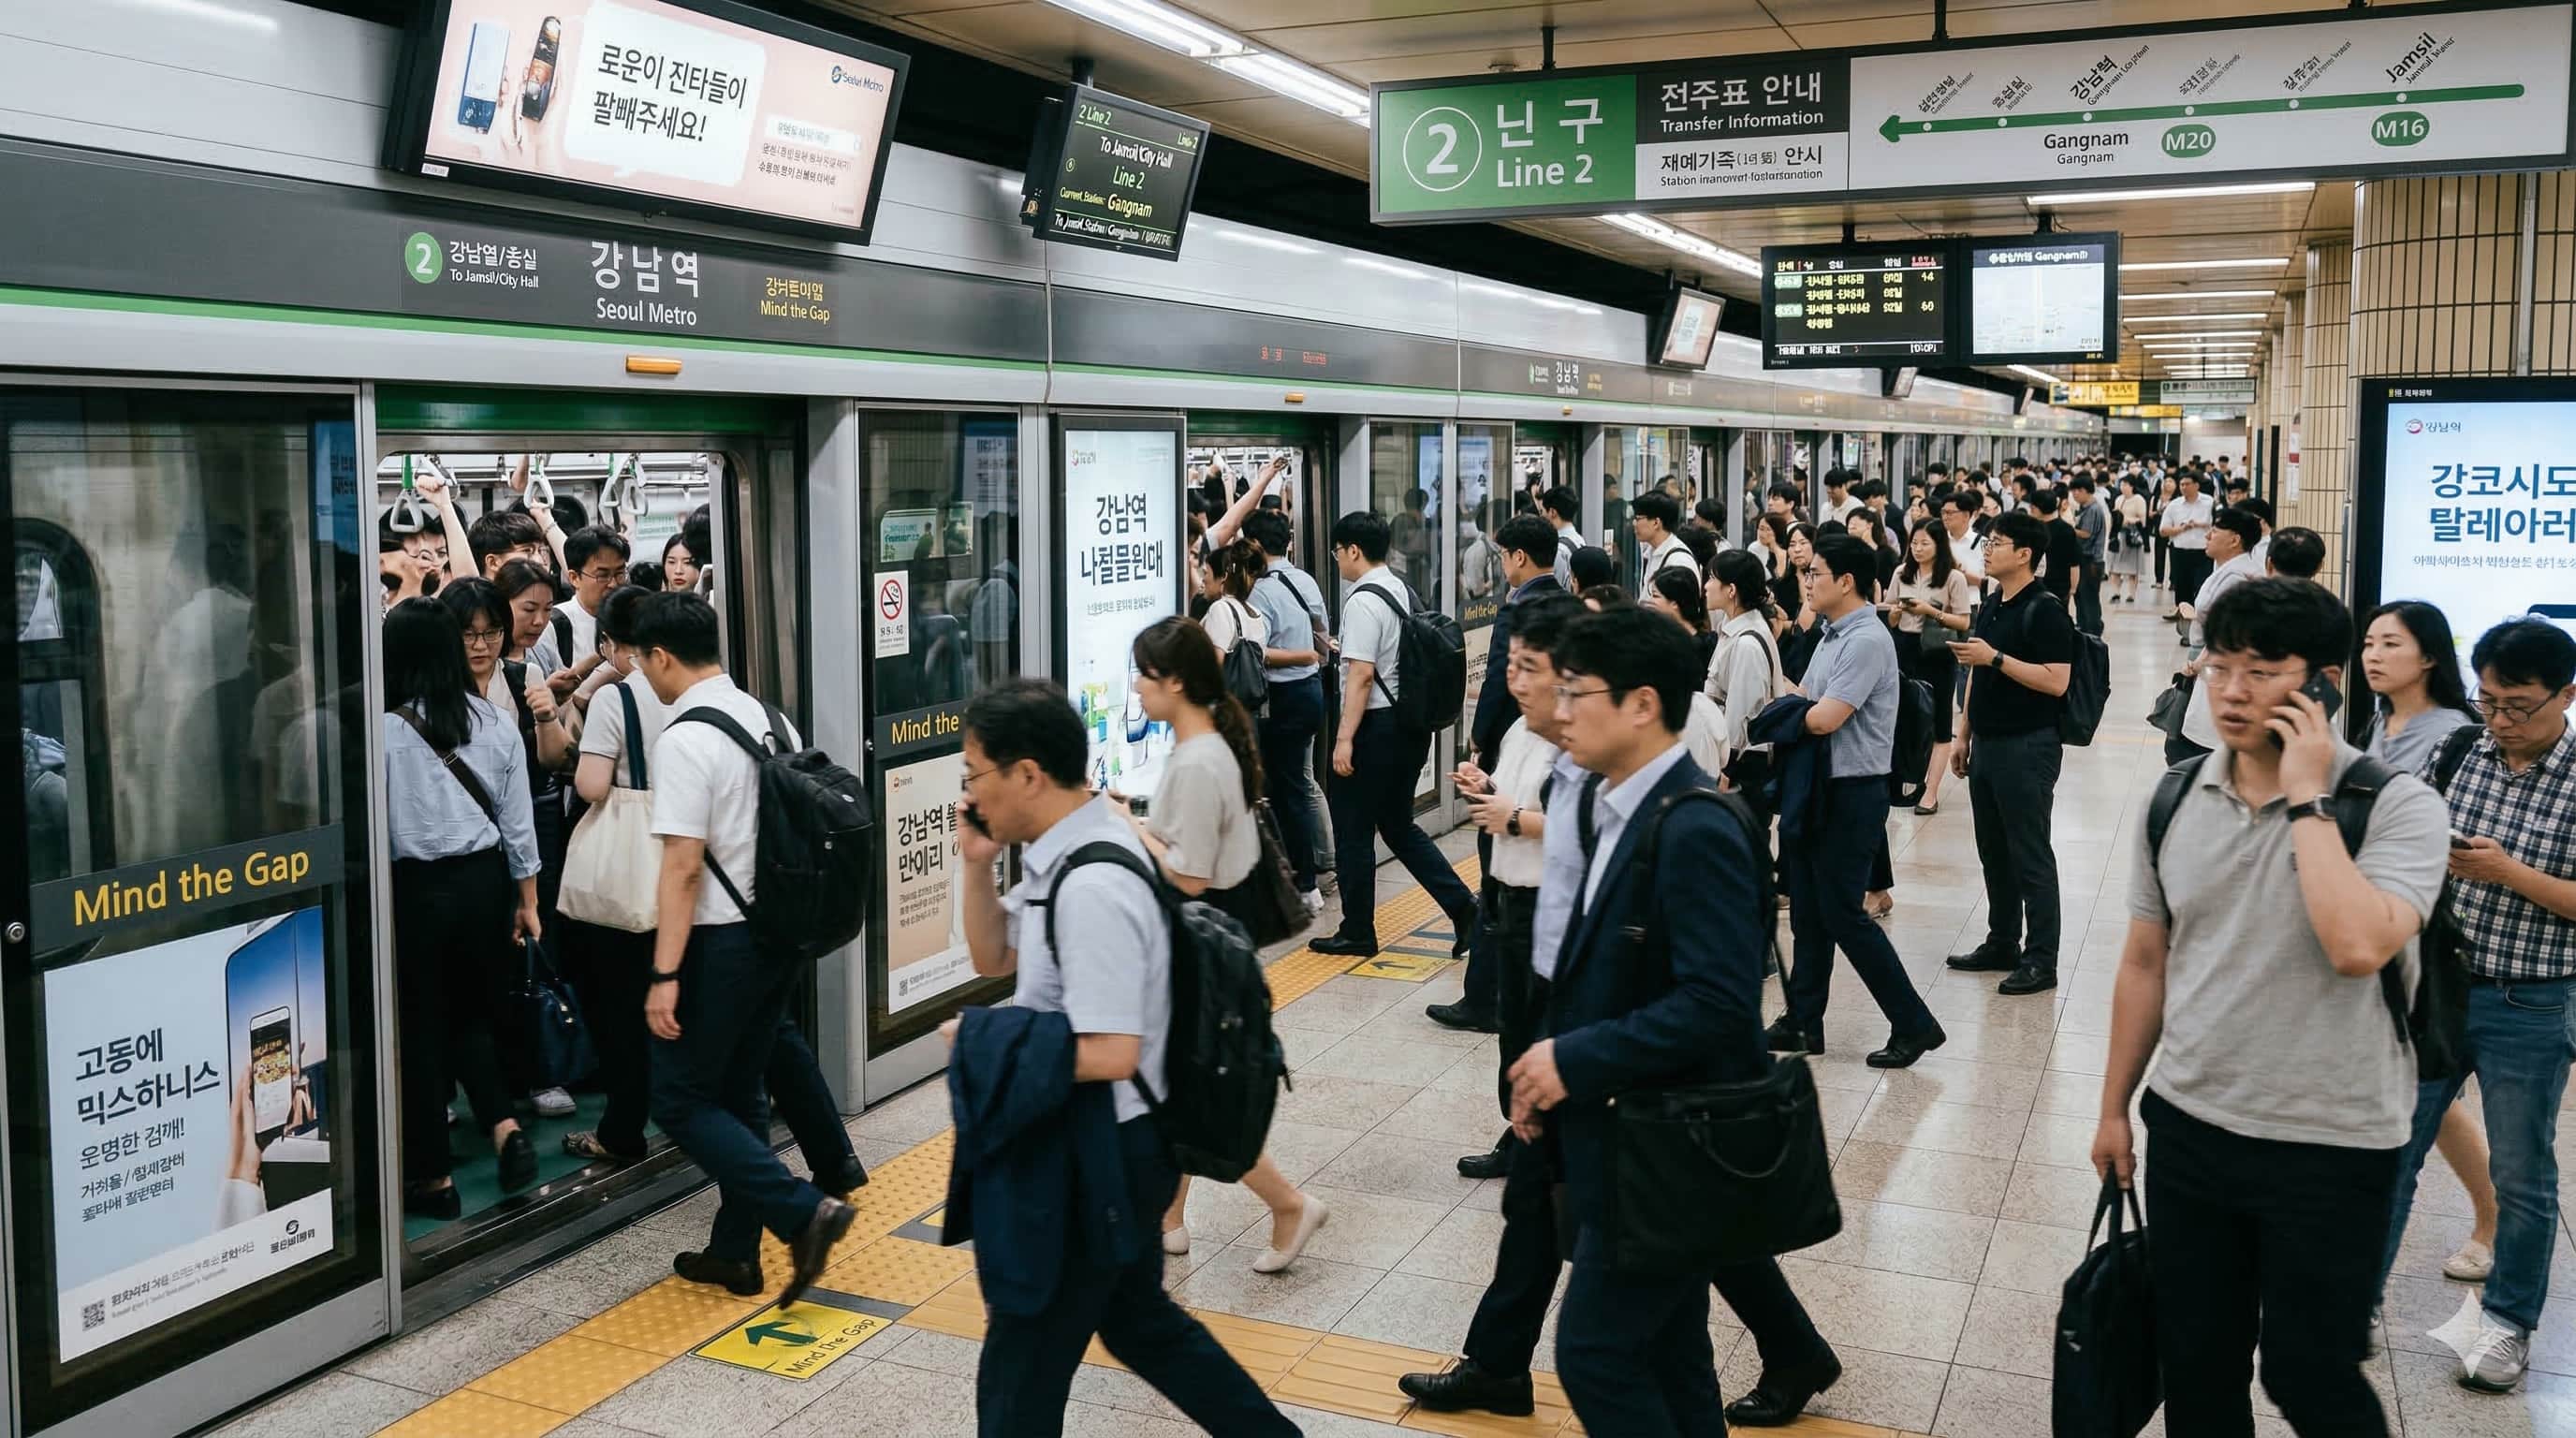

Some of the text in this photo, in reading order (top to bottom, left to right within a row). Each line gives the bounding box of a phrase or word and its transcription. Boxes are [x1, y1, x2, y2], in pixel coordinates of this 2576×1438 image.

[2385, 32, 2437, 83] Jamsil
[598, 44, 747, 110] 로운이 진타들이
[1661, 71, 1822, 112] 전주표 안내
[593, 90, 706, 141] 팔빼주세요!
[1087, 105, 1105, 123] Line
[1497, 97, 1603, 148] 닌 구
[1660, 110, 1823, 133] Transfer Information
[2376, 118, 2425, 139] M16
[1425, 123, 1458, 174] 2
[1784, 145, 1822, 166] 안시
[2043, 132, 2130, 152] Gangnam
[2165, 131, 2212, 151] M20
[1498, 154, 1594, 187] Line 2
[2056, 152, 2115, 166] Gangnam
[1113, 165, 1146, 190] Line 2
[1107, 193, 1153, 218] Gangnam
[415, 242, 433, 274] 2
[591, 240, 698, 299] 강남역
[449, 268, 463, 282] To
[520, 274, 538, 288] Hall
[596, 297, 697, 326] Seoul Metro
[760, 300, 830, 325] Mind the Gap
[2431, 463, 2576, 500] 강코시도
[1096, 492, 1147, 536] 강남역
[891, 711, 959, 745] Mind the
[898, 804, 944, 846] 강남역
[74, 850, 310, 926] Mind the Gap
[76, 1027, 164, 1081] 고동에
[78, 1061, 221, 1125] 믹스하니스
[80, 1131, 141, 1170] 운명한
[784, 1350, 827, 1373] Mind
[842, 1318, 877, 1336] Gap
